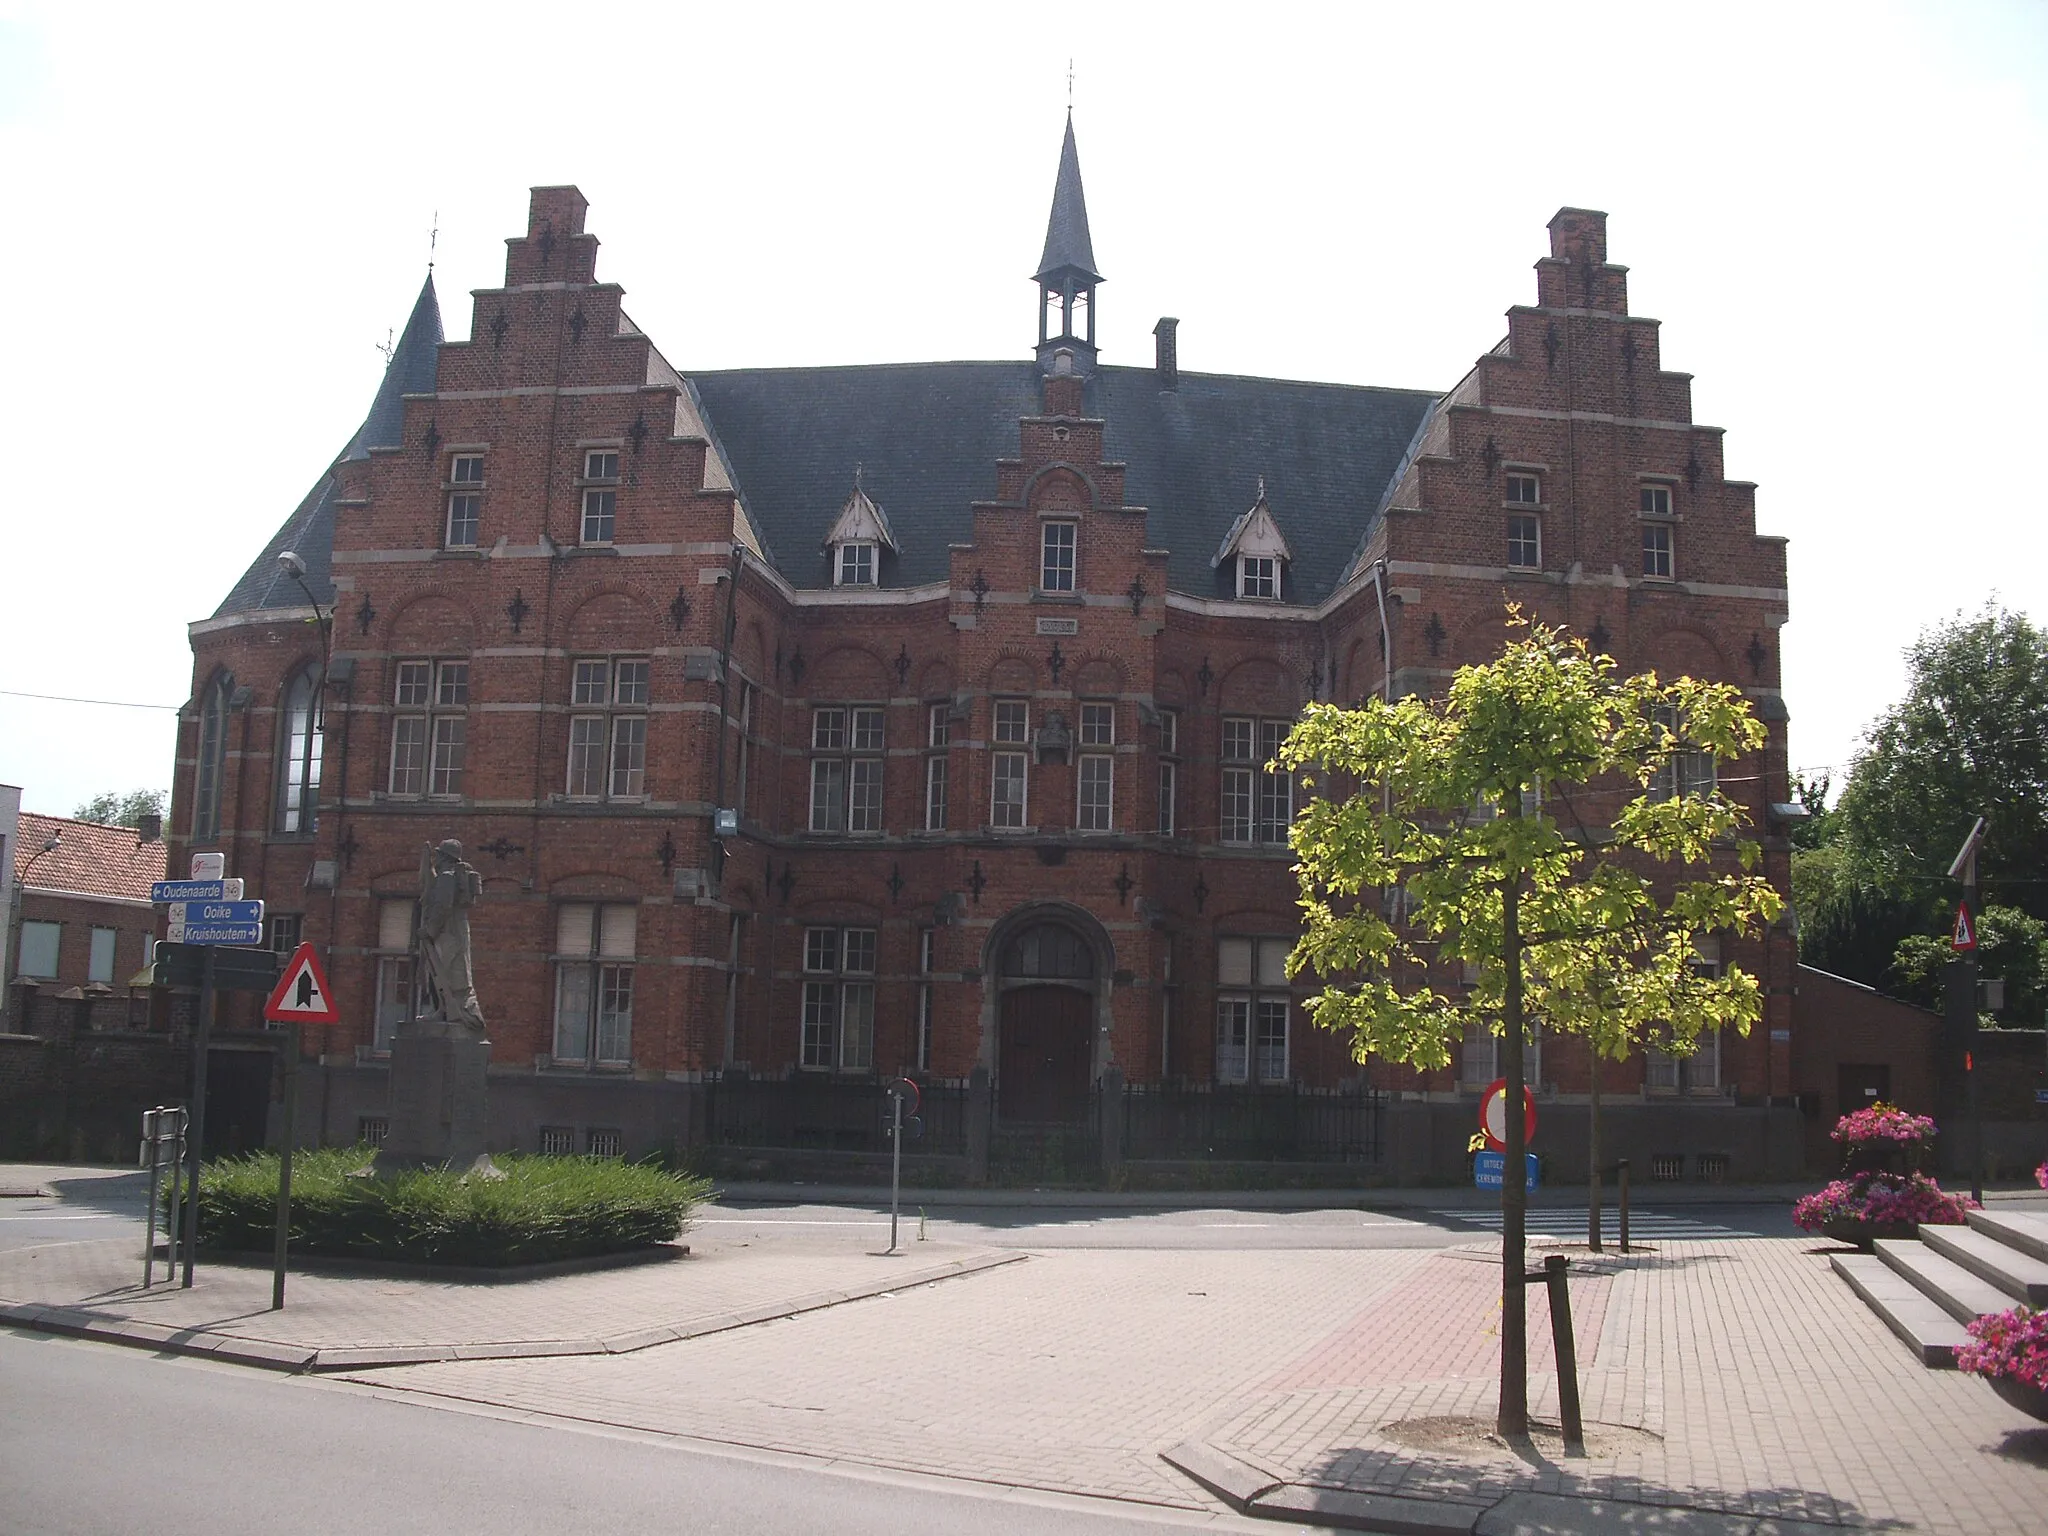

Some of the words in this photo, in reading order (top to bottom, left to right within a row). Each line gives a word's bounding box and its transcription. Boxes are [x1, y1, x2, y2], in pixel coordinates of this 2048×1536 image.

[163, 884, 220, 898] Oudenaarde
[203, 905, 232, 919] Ooike
[185, 927, 247, 941] Kruishoutem
